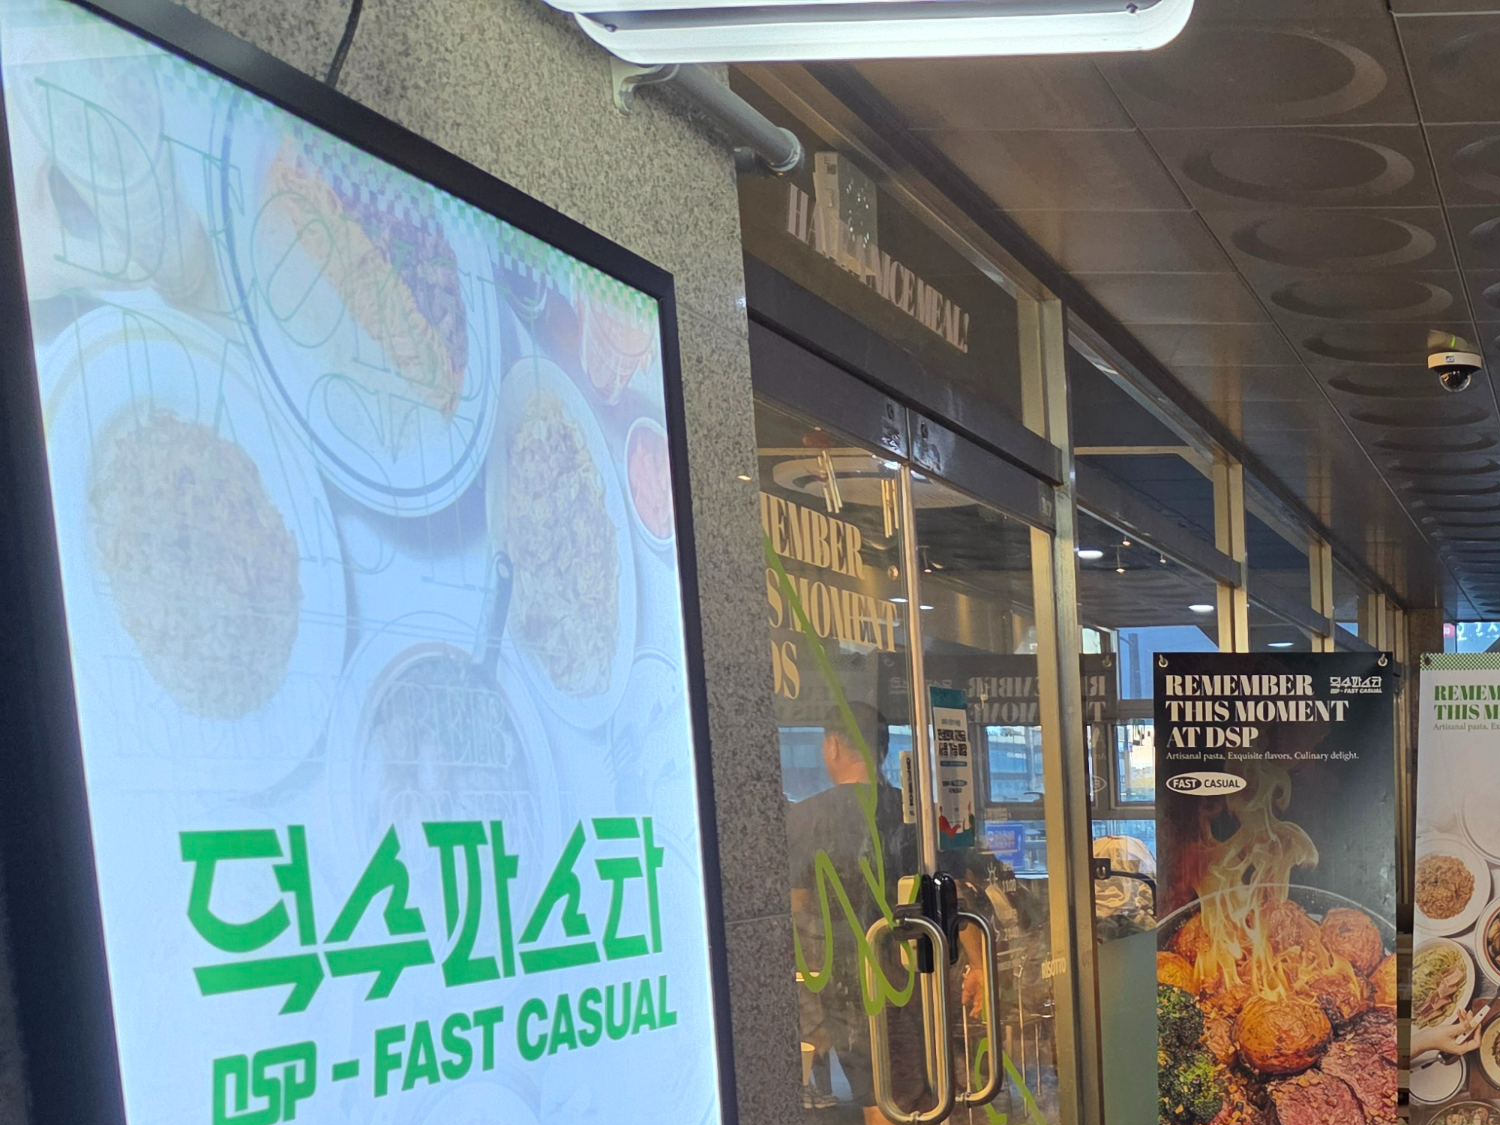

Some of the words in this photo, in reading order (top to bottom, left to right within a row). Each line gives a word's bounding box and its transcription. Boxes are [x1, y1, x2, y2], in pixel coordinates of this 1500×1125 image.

[1165, 674, 1314, 696] REMEMBER
[1165, 701, 1229, 722] THIS
[1234, 701, 1349, 722] MOMENT
[1434, 704, 1480, 720] THIS
[1433, 722, 1466, 731] Artisanal
[1166, 727, 1201, 748] AT
[1206, 727, 1259, 748] DSP
[1166, 752, 1202, 760] Artisanal
[1203, 752, 1226, 761] pasta,
[1228, 751, 1263, 761] Exquisite
[1264, 751, 1293, 760] flavors,
[1294, 751, 1329, 761] Culinary
[1330, 751, 1360, 761] delight.
[1173, 779, 1198, 788] FAST
[1204, 779, 1240, 788] CASUAL
[179, 816, 664, 1016] 덕수파스타
[374, 1005, 504, 1098] FAST
[516, 975, 677, 1061] CASUAL
